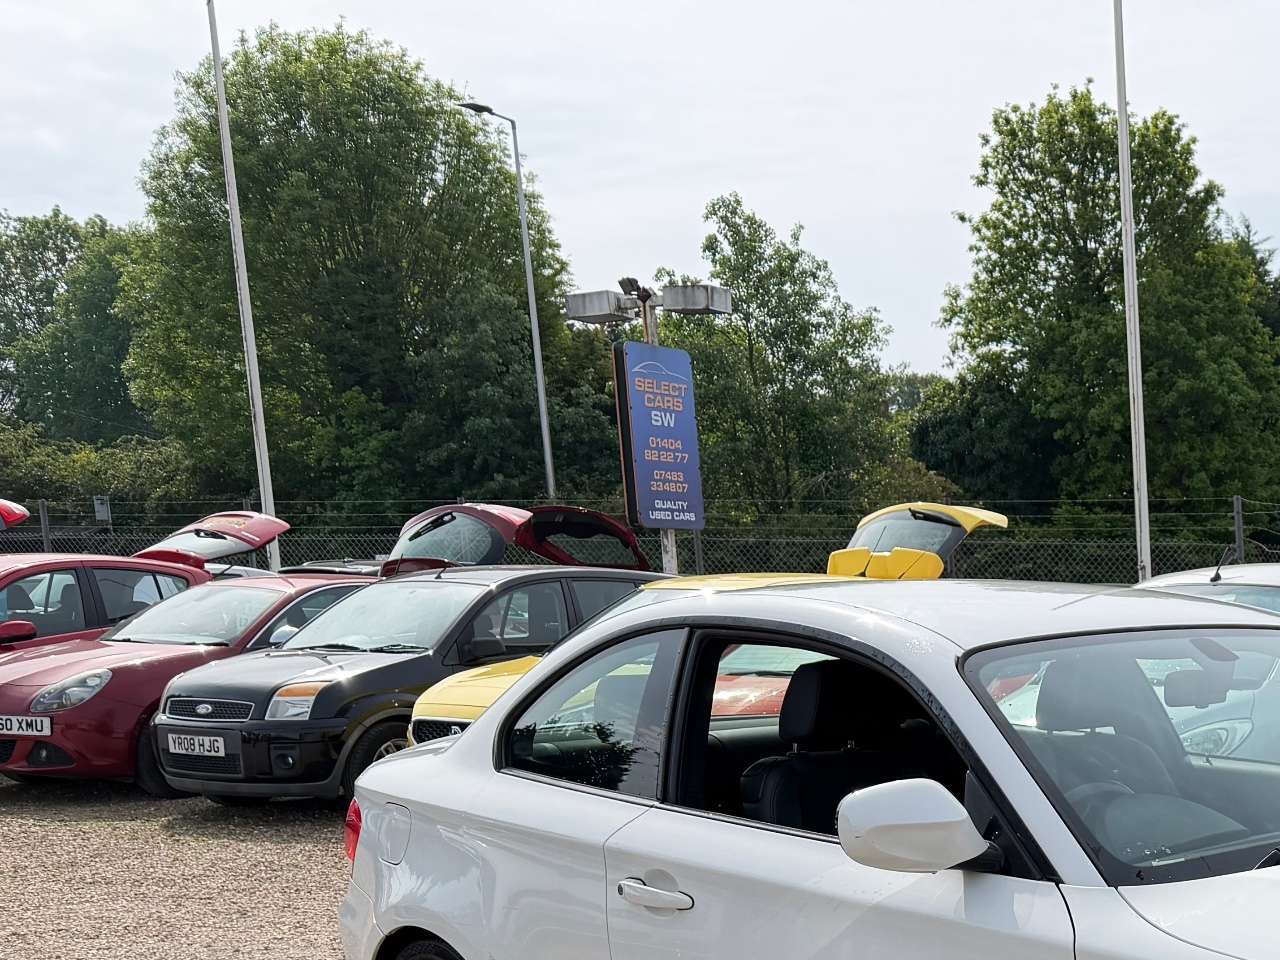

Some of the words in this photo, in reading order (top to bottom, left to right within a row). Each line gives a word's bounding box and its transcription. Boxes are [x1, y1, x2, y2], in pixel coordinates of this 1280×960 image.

[635, 377, 688, 397] SELECT
[644, 394, 684, 412] CARS
[651, 411, 675, 428] SW
[649, 436, 683, 450] 01404
[654, 499, 688, 510] QUALITY
[649, 510, 672, 520] USED
[673, 512, 696, 521] CARS
[16, 718, 44, 732] XMU
[171, 736, 196, 751] YR08
[197, 738, 220, 753] HJG
